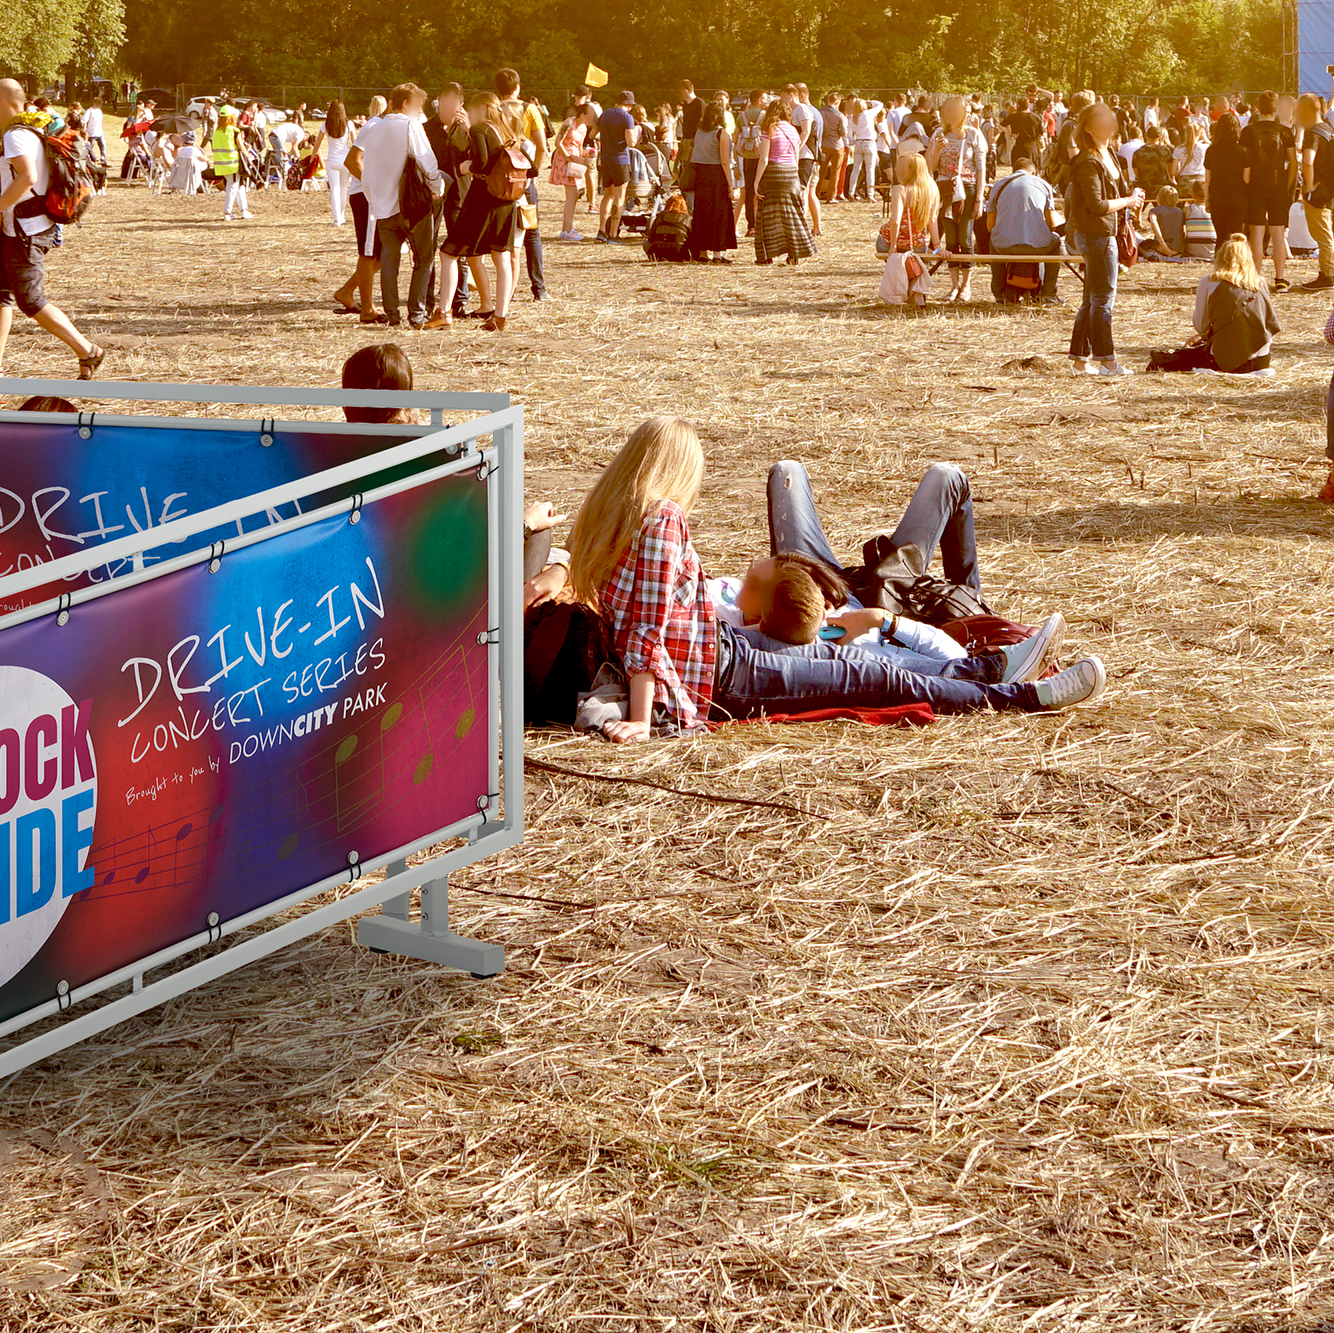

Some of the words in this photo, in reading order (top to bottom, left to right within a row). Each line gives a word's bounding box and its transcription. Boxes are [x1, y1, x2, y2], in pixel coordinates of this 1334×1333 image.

[118, 557, 385, 727] DRIVE-IN
[131, 678, 271, 763] CONCERT
[282, 638, 386, 703] SERIES
[125, 777, 167, 805] Brought
[171, 771, 183, 783] to
[188, 767, 205, 784] you
[208, 755, 220, 773] by
[229, 702, 339, 764] DOWNCITY
[343, 682, 387, 718] PARK
